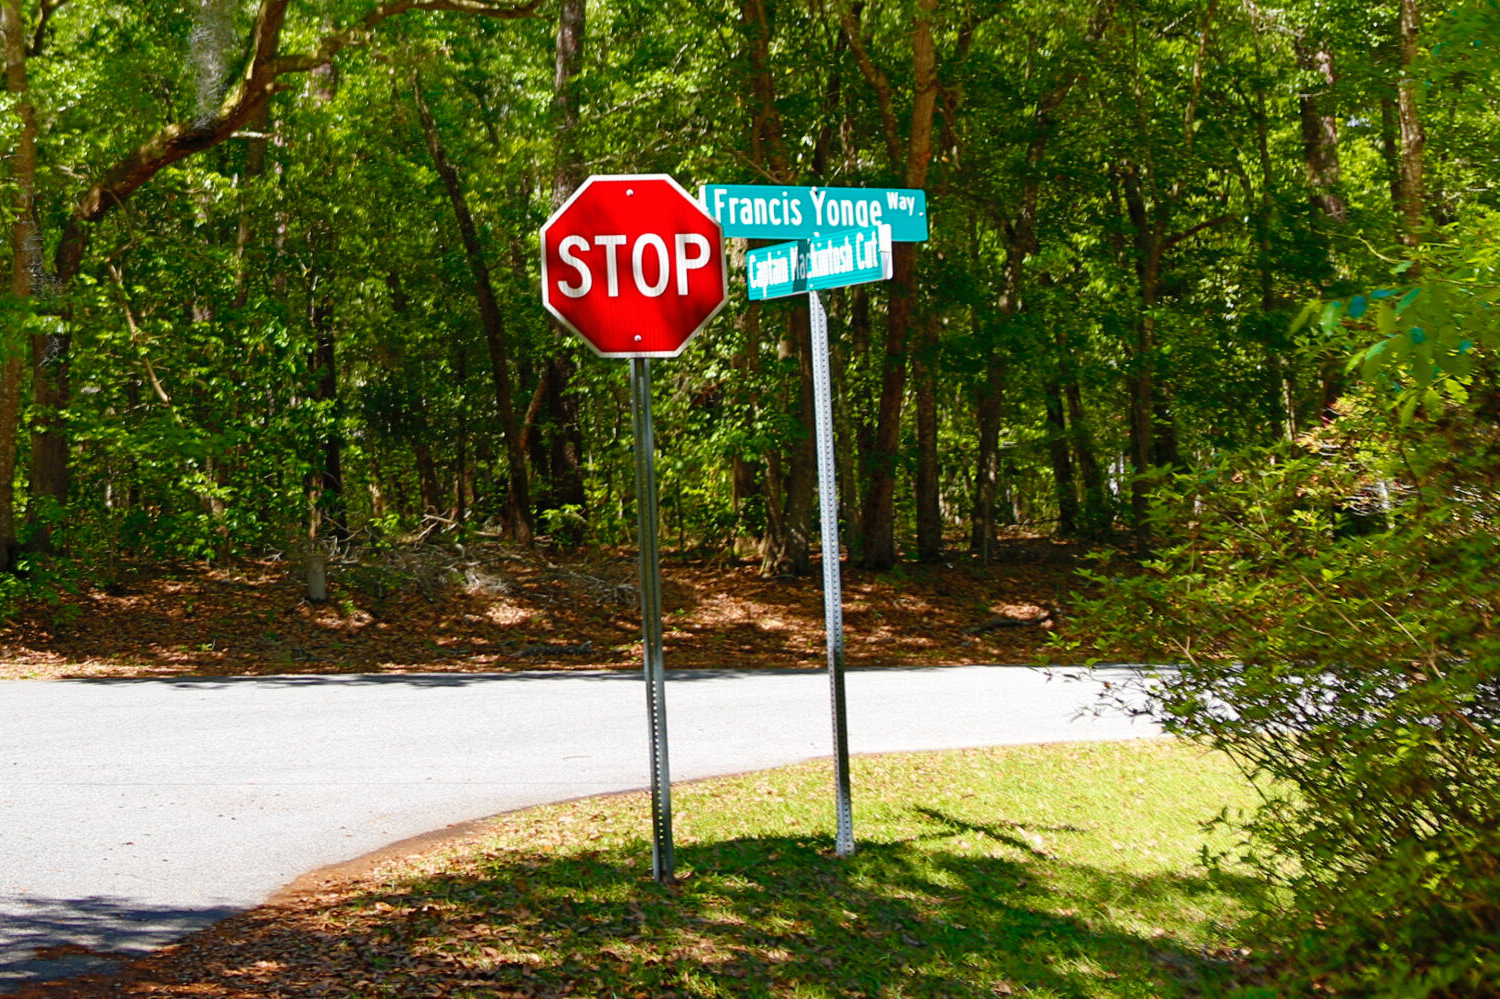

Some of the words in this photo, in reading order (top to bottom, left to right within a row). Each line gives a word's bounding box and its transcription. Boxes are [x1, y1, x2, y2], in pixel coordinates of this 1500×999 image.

[713, 187, 803, 227] Francis
[809, 190, 884, 228] Yonge
[886, 191, 916, 217] Way
[557, 232, 712, 298] STOP
[748, 250, 790, 298] Captain
